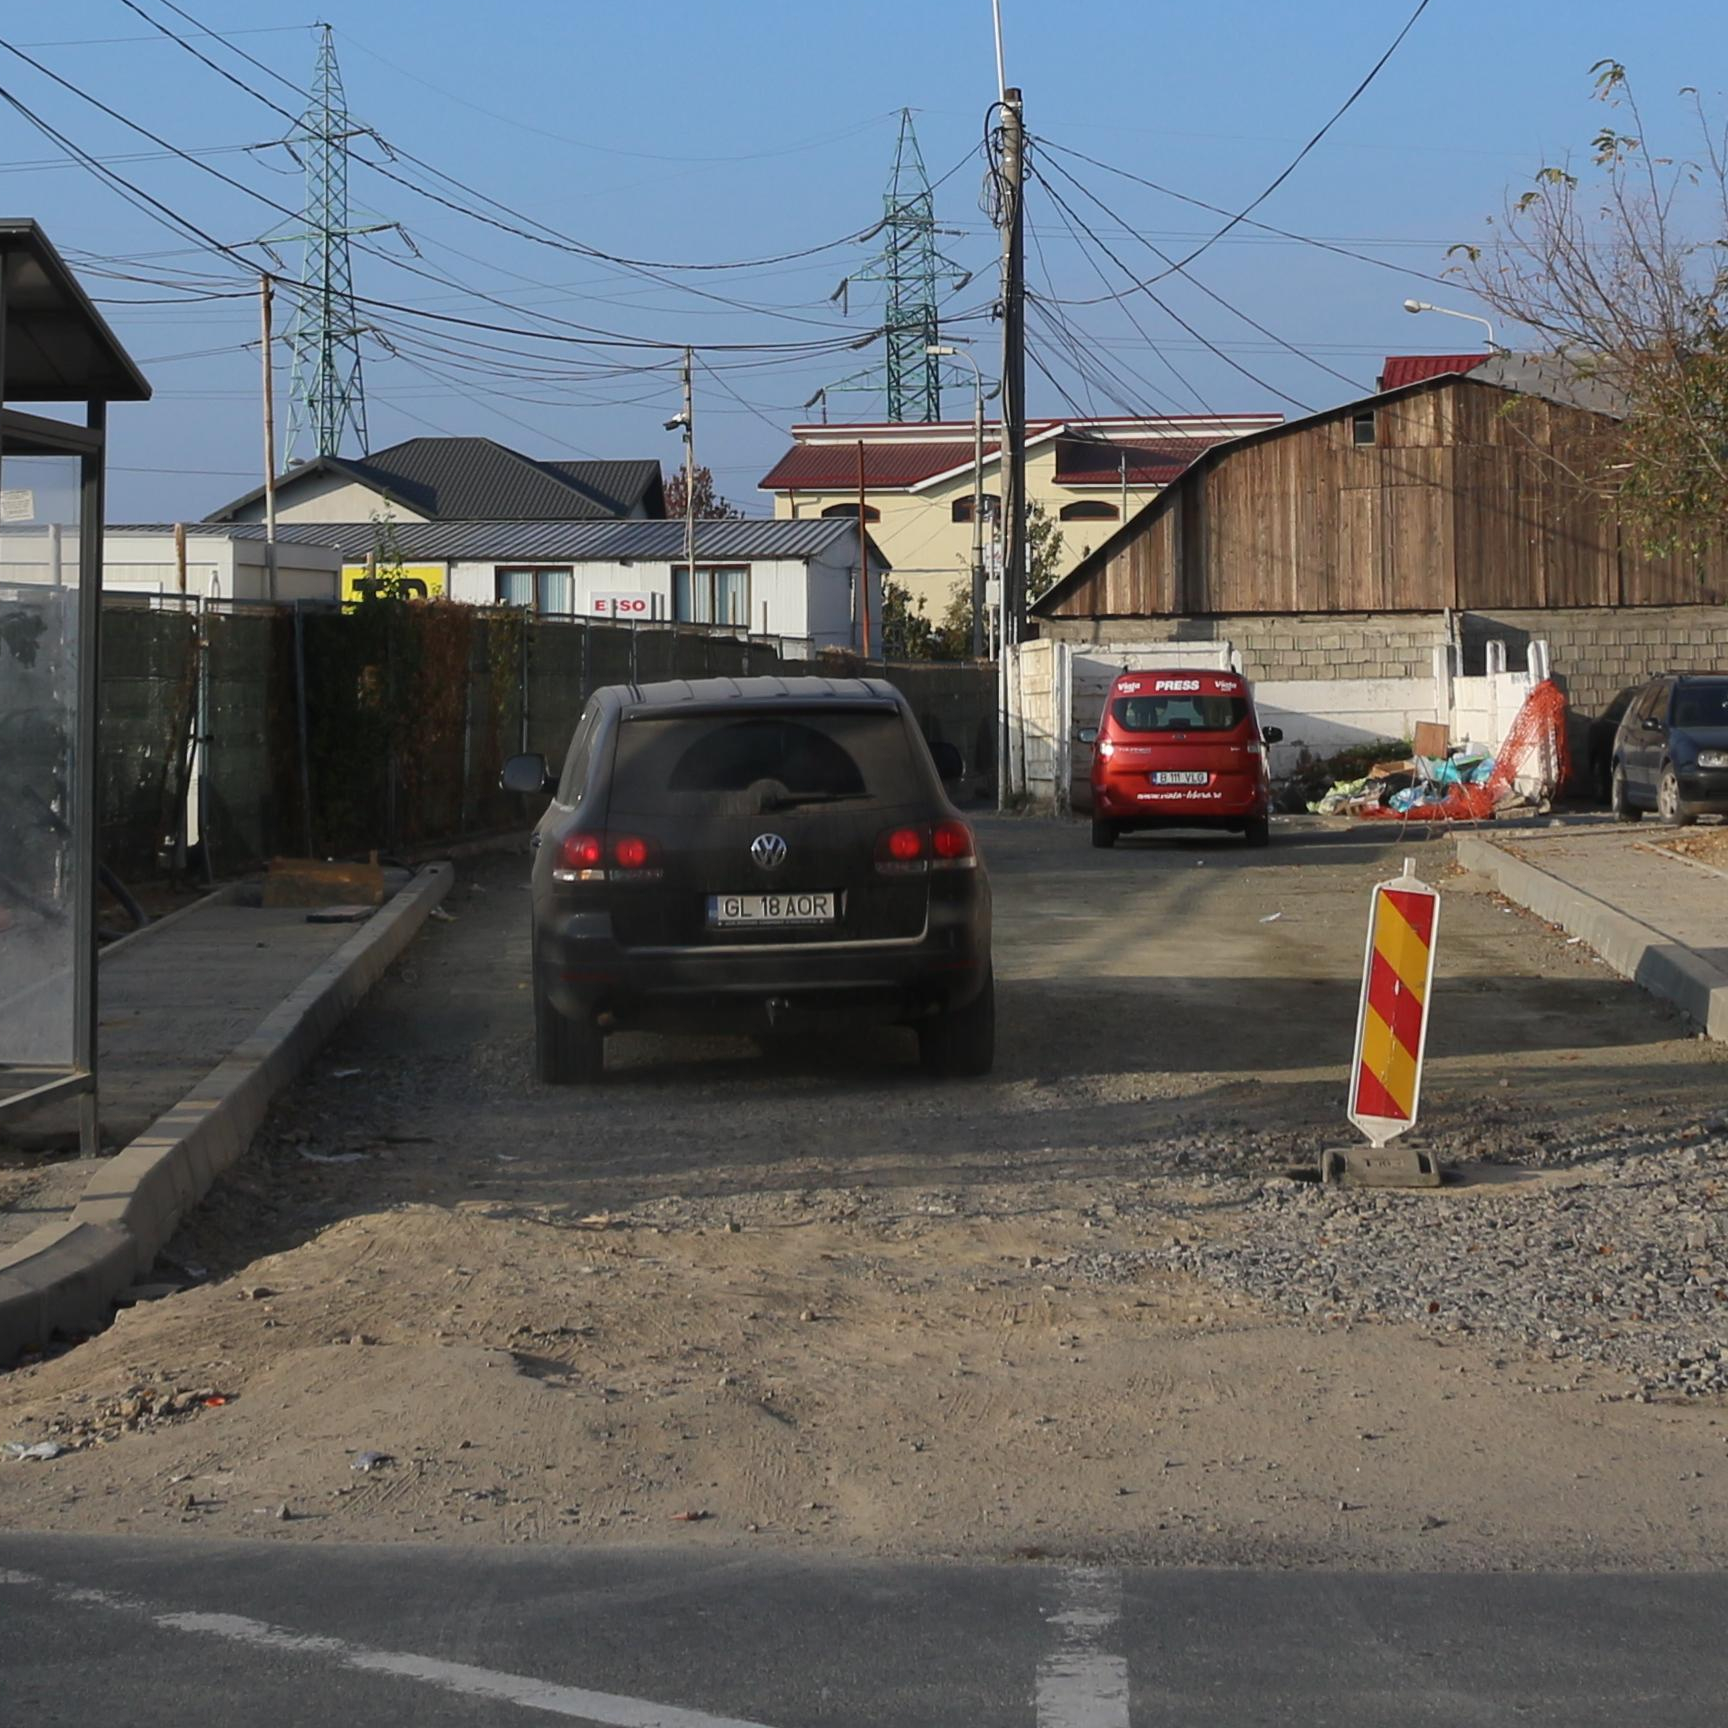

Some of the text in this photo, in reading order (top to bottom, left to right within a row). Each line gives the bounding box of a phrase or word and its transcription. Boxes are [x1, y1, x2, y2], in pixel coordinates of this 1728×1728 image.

[594, 599, 646, 612] ESO
[1155, 680, 1200, 692] PRESS
[1171, 773, 1181, 783] 111
[725, 896, 827, 917] GL 18 AOR
